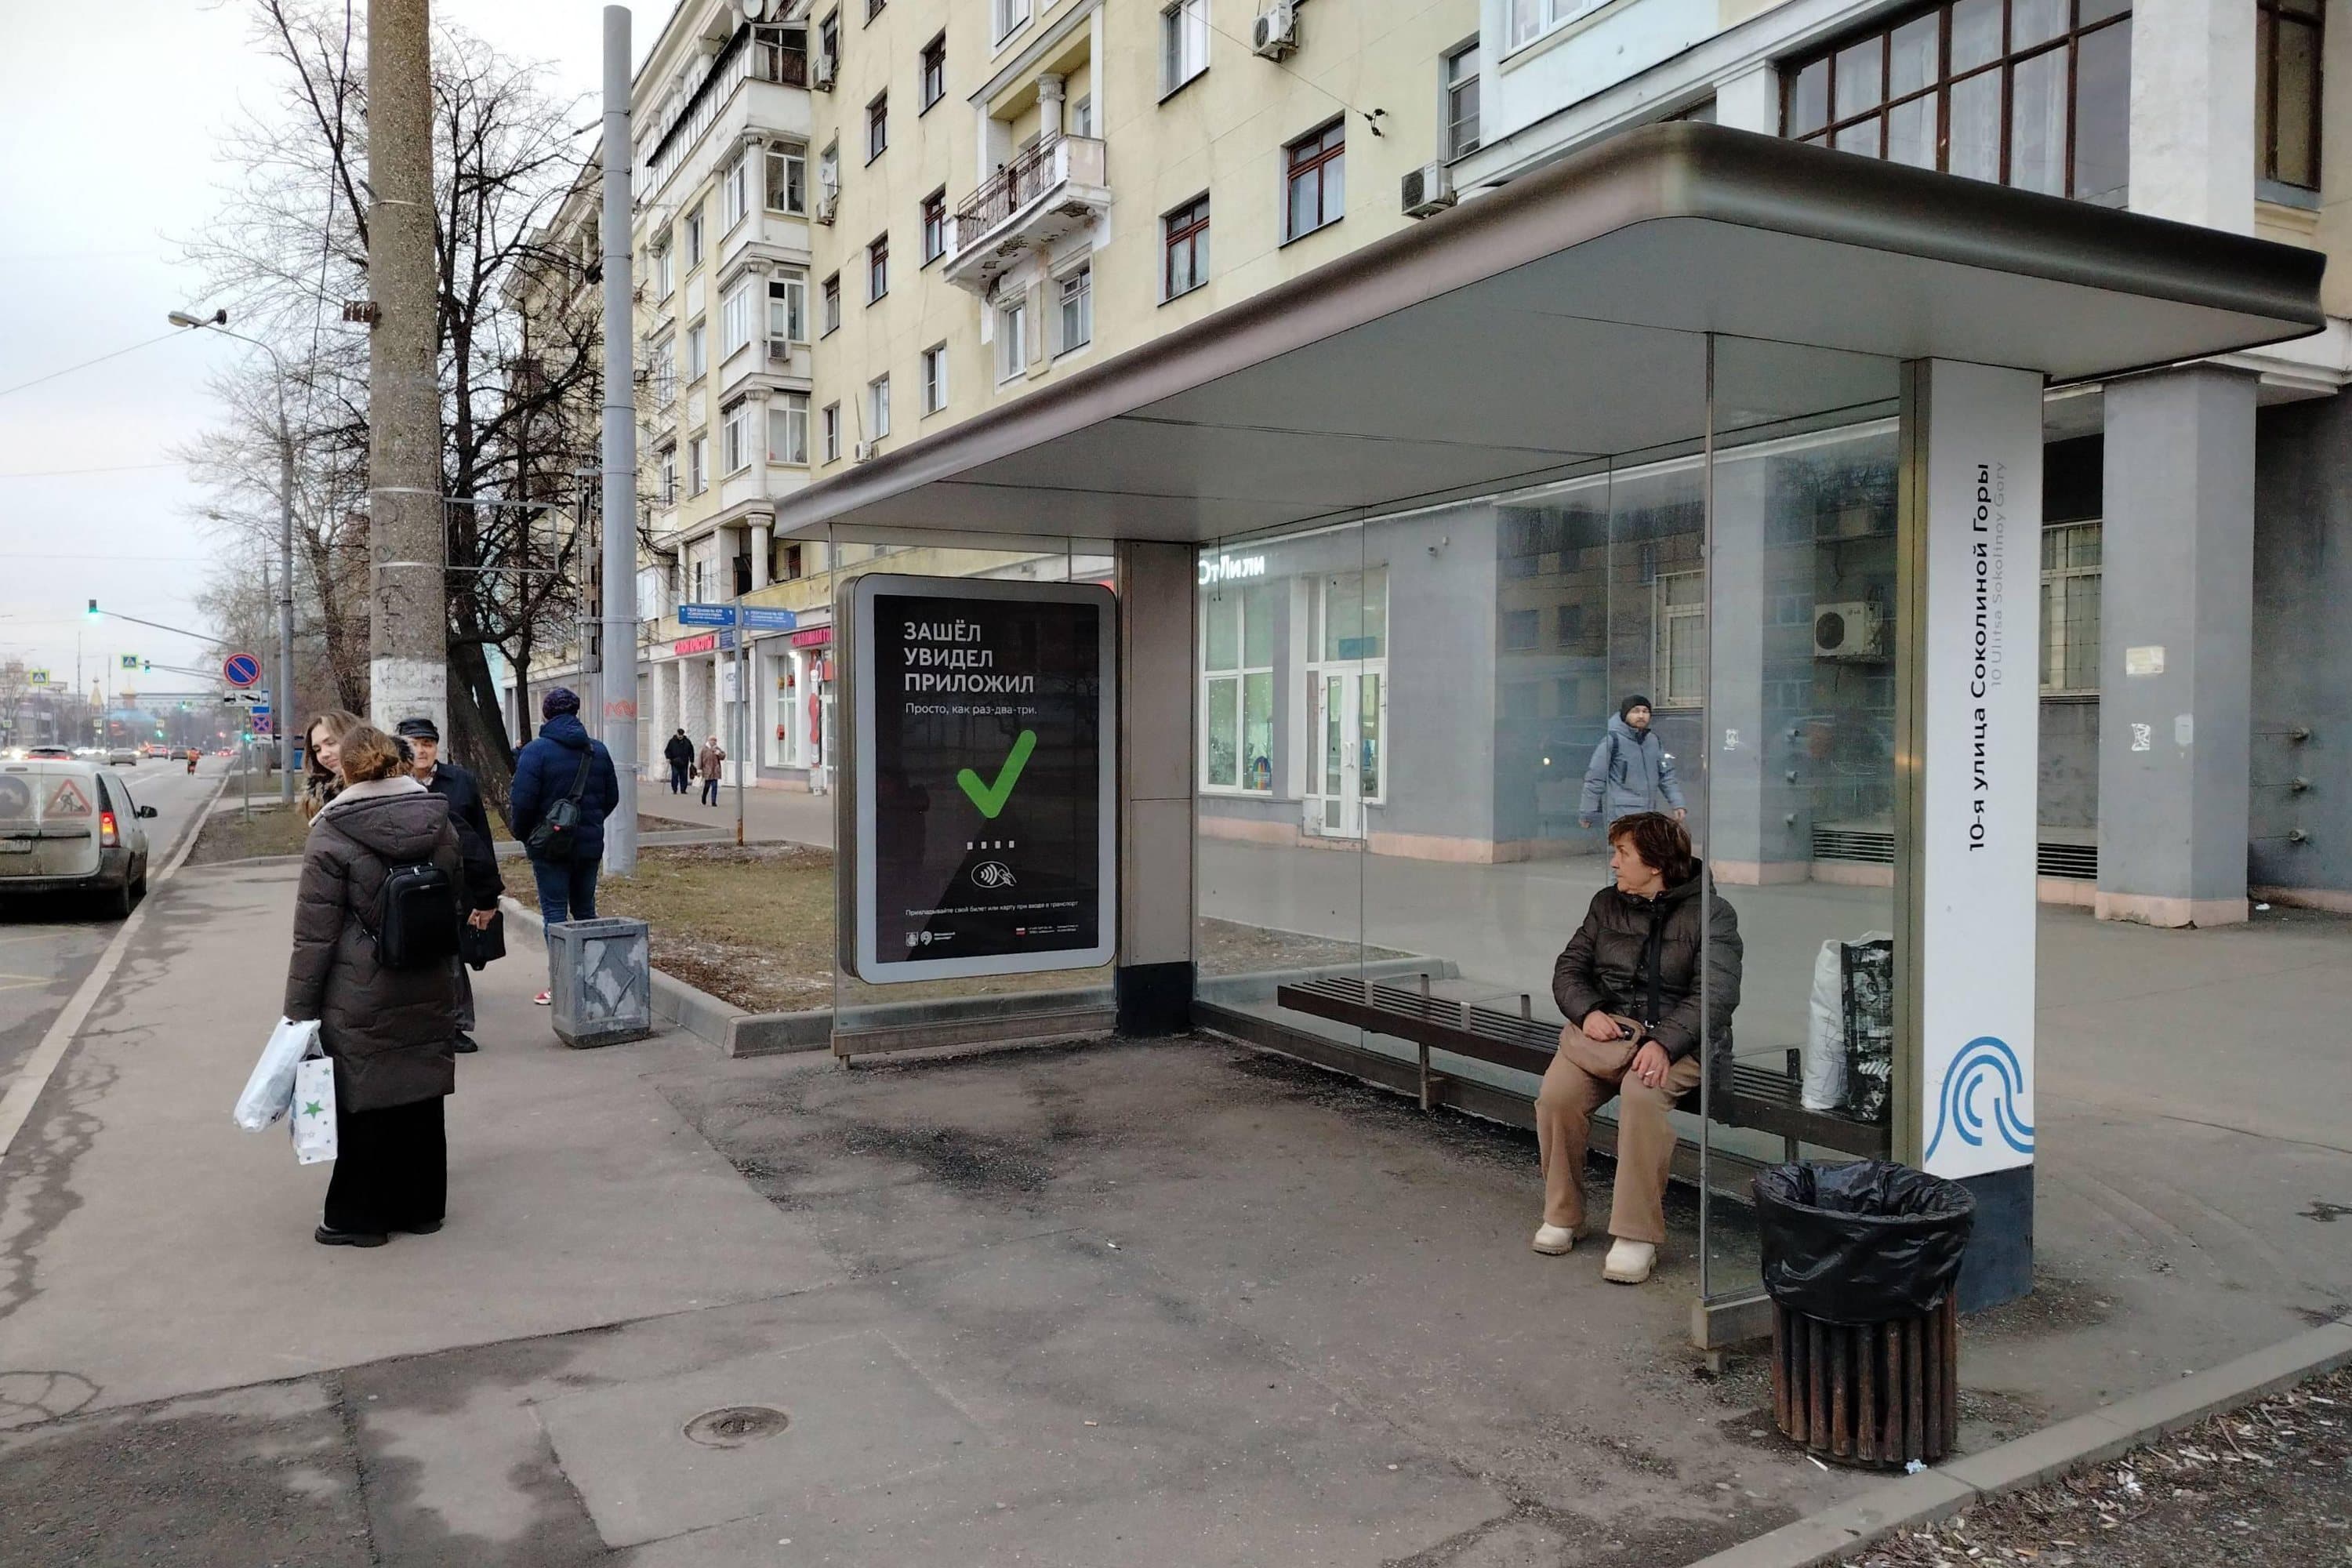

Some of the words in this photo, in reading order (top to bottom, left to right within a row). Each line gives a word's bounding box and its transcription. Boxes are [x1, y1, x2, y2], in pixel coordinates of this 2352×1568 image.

[1973, 464, 1991, 532] Горы
[1994, 462, 2007, 507] Gory
[1992, 512, 2006, 604] Sokolinoy
[903, 619, 981, 642] ЗАШЁЛ
[1970, 543, 1987, 699] Соколиной
[1991, 610, 2002, 664] Ulitsa
[903, 647, 993, 670] УВИДЕЛ
[1991, 669, 2002, 687] 10
[905, 673, 1034, 693] ПРИЛОЖИЛ
[906, 702, 949, 715] Просто,
[952, 705, 970, 714] как
[972, 706, 1037, 716] раз-два-три.
[1974, 708, 1988, 790] улица
[1969, 800, 1985, 851] 10-я
